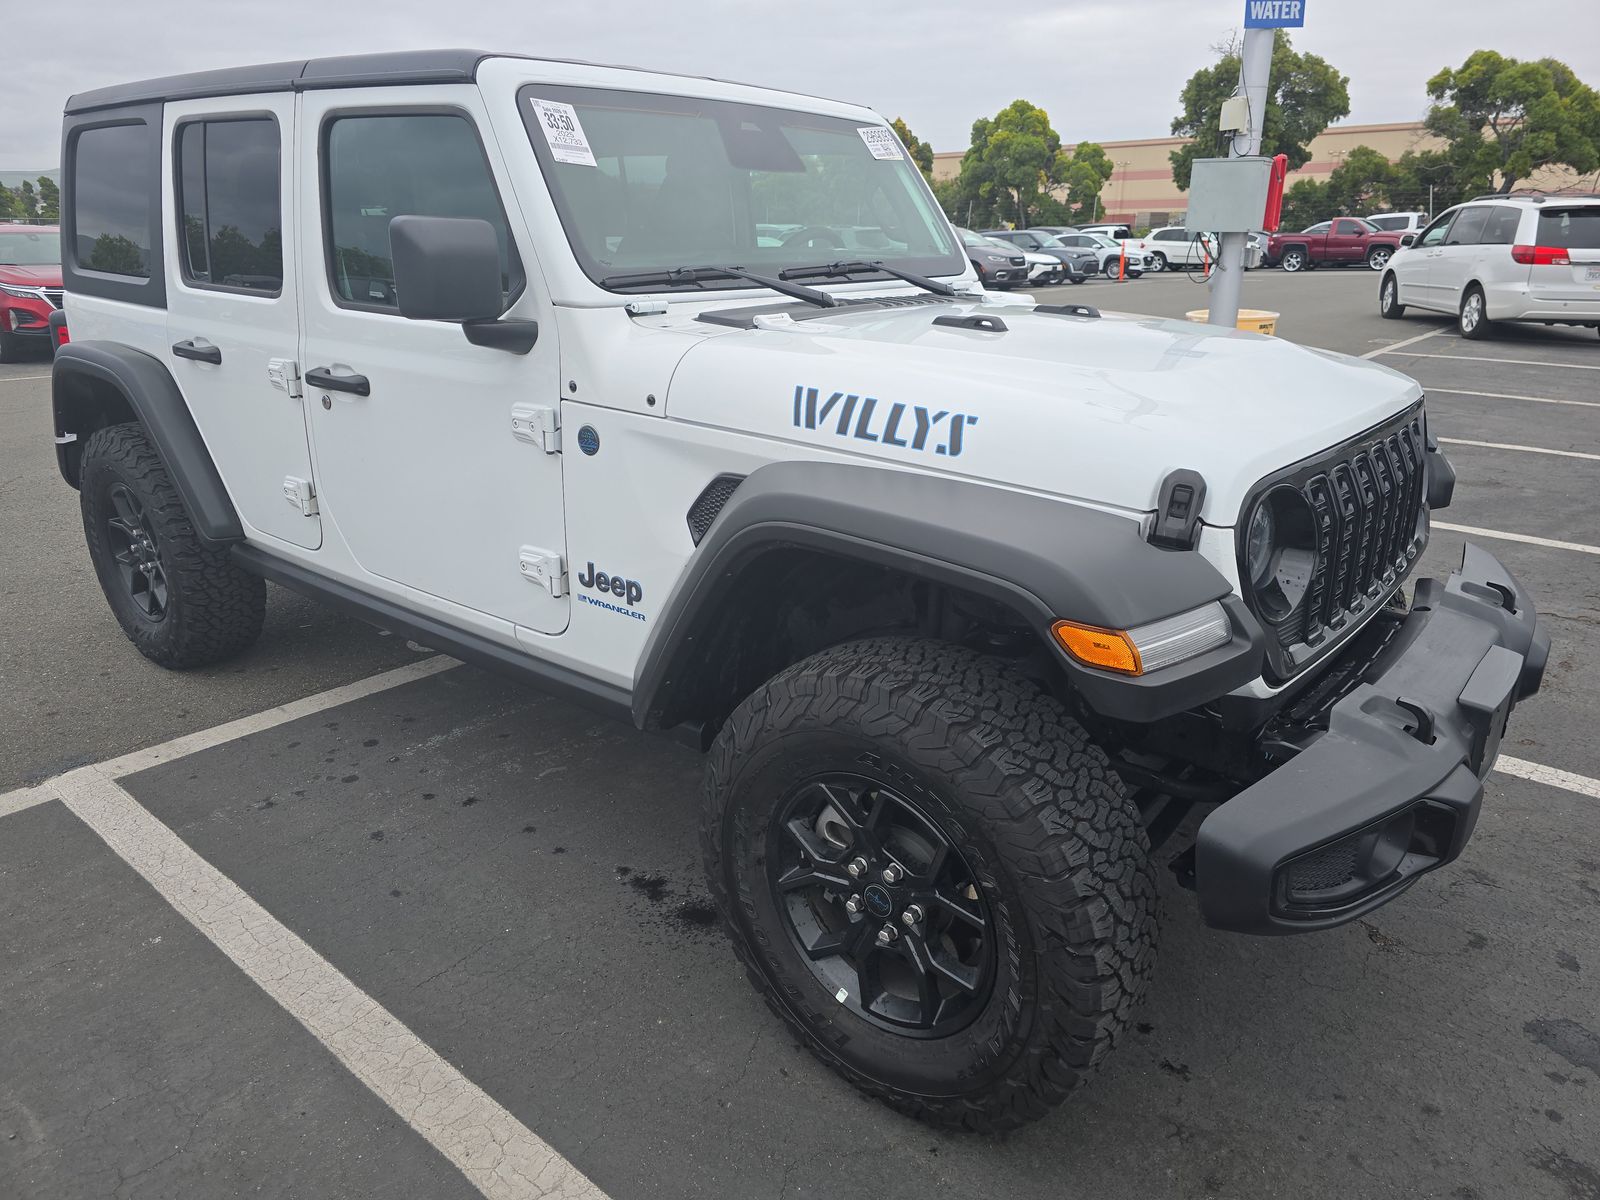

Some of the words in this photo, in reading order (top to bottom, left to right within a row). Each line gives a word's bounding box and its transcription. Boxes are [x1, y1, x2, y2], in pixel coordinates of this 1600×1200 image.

[1250, 1, 1300, 19] WATER
[544, 112, 575, 131] 33:50
[556, 130, 575, 138] 2025
[793, 385, 978, 457] WILLYS
[578, 561, 643, 606] Jeep
[587, 596, 646, 622] WRANGLER
